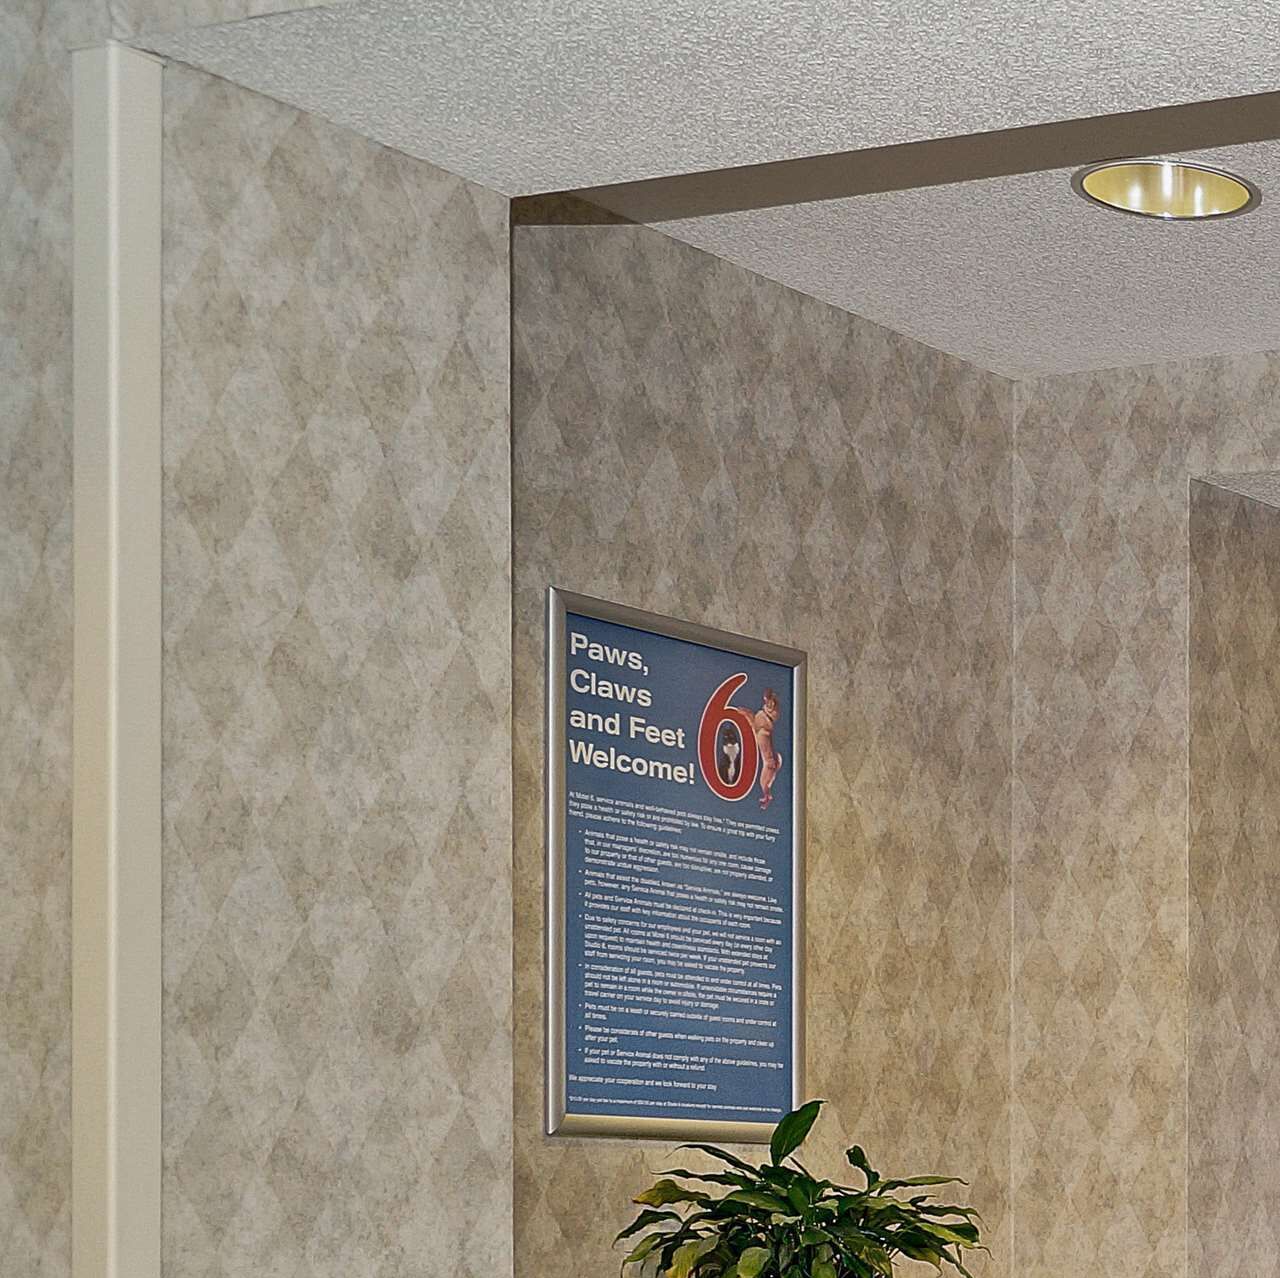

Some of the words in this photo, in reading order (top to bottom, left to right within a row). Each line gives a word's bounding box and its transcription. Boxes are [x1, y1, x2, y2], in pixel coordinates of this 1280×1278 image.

[570, 632, 649, 676] Paws,
[570, 668, 653, 707] Claws
[569, 709, 620, 736] and
[629, 716, 685, 749] Feet
[698, 672, 759, 802] 6
[569, 739, 695, 785] Welcome!
